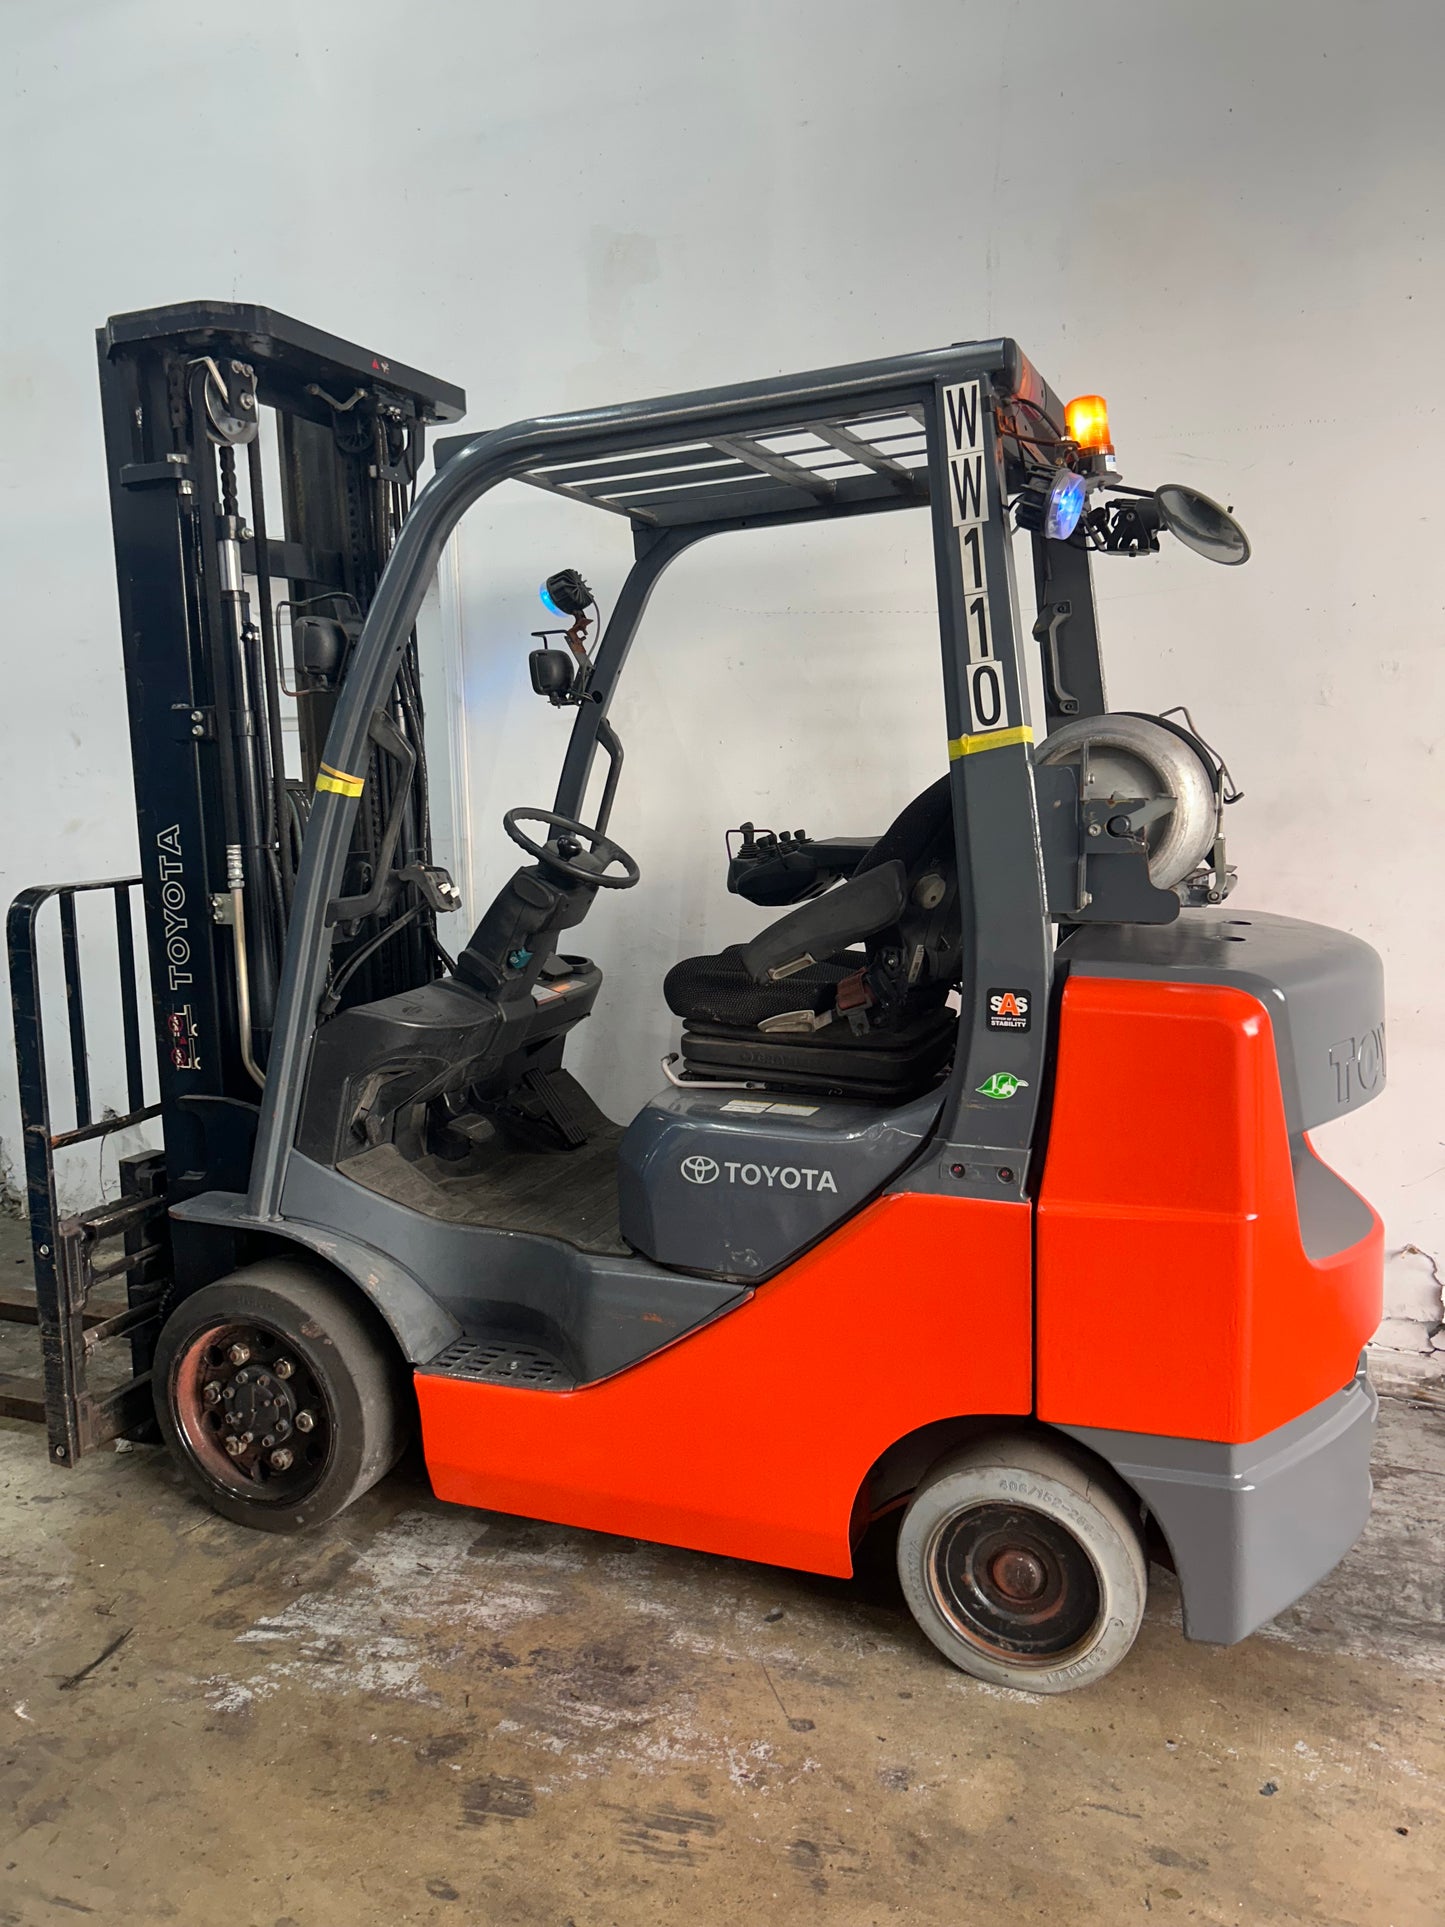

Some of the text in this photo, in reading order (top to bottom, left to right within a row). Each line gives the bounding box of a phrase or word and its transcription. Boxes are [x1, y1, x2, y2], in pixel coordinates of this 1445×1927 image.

[157, 824, 193, 991] TOYOTA
[990, 993, 1028, 1016] SAS
[724, 1162, 838, 1193] TOYOTA
